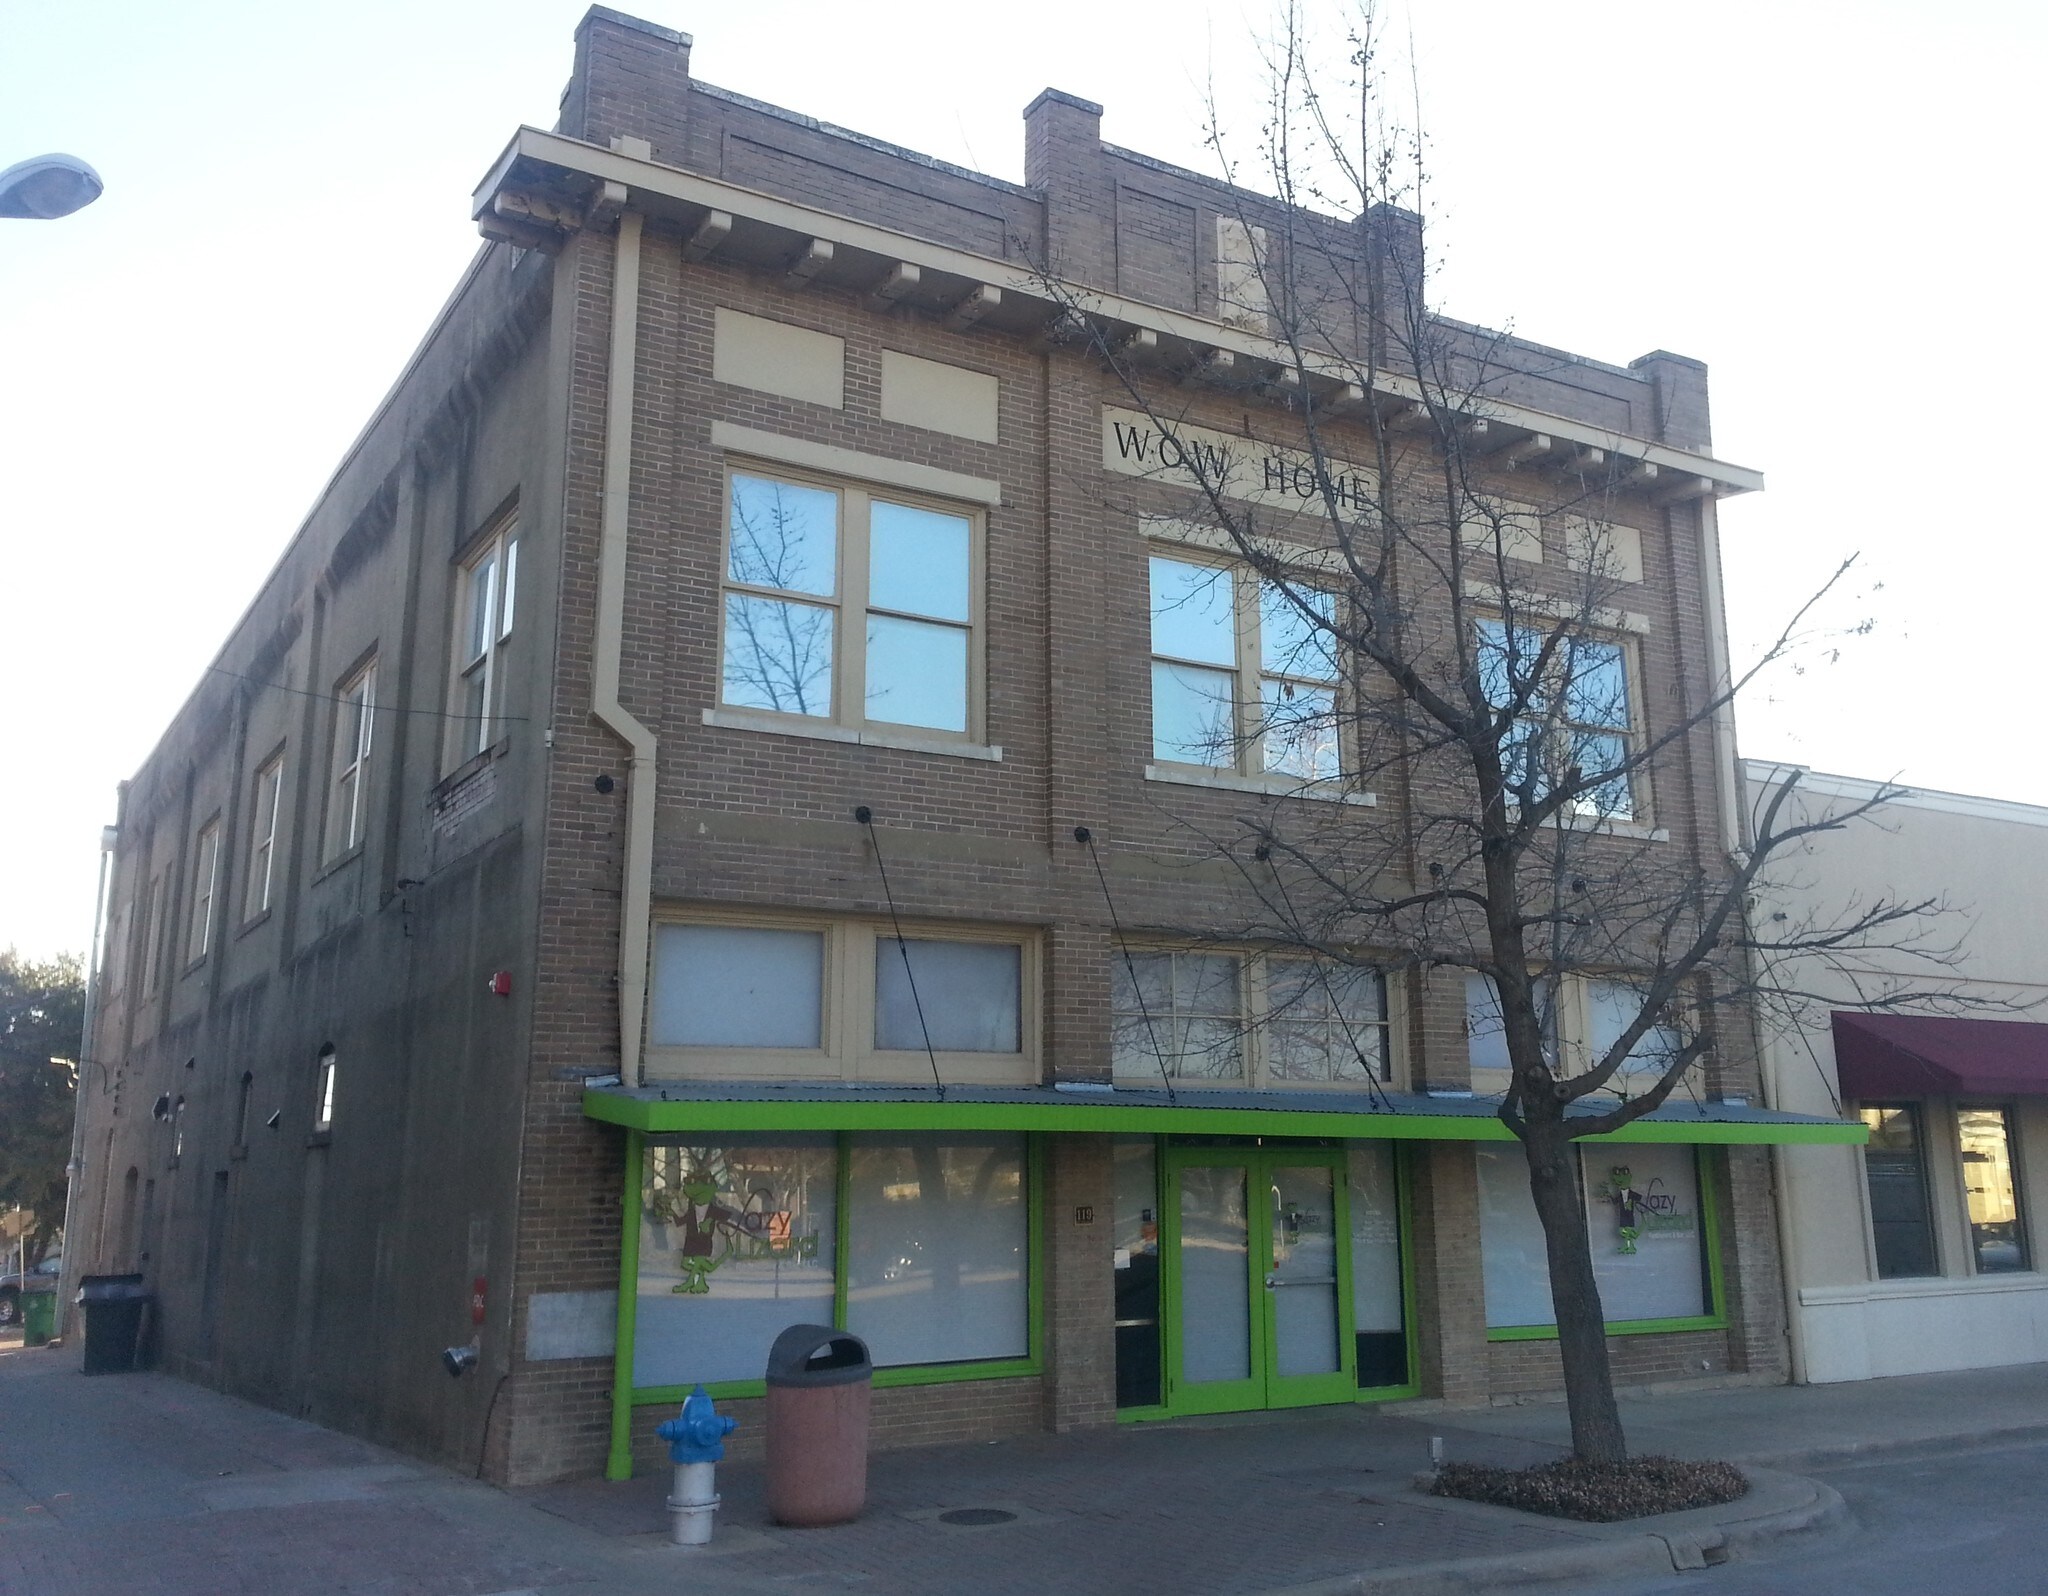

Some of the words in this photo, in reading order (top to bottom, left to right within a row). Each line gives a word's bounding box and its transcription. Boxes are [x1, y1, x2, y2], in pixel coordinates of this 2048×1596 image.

[1263, 457, 1370, 512] HOME
[716, 1187, 792, 1240] Lazy
[1077, 1208, 1093, 1221] 119
[1634, 1177, 1676, 1217] Lazy
[736, 1228, 819, 1260] Lizard
